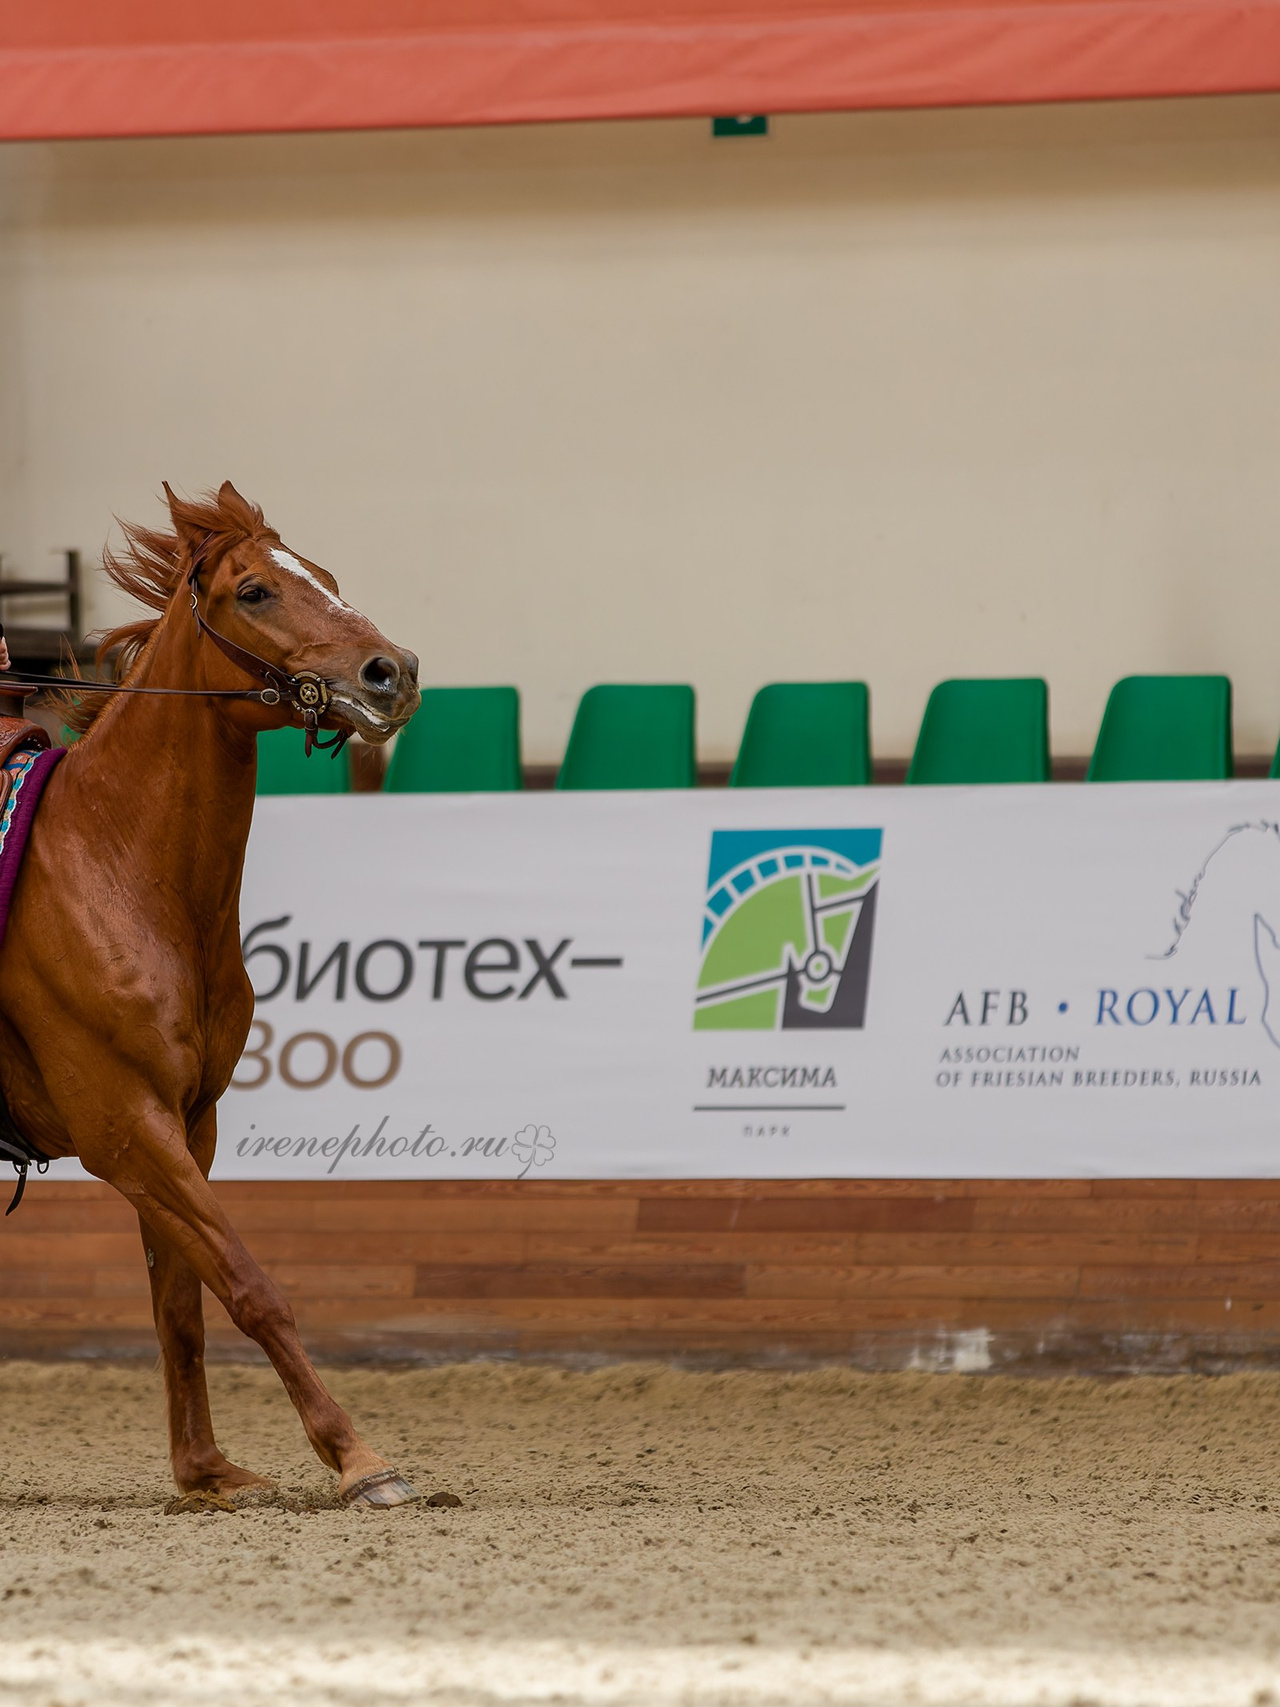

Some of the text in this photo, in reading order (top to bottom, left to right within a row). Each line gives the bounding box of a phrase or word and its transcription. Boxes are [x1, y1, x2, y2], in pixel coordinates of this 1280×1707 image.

[943, 987, 1247, 1026] AFB ROYAL
[939, 1046, 1080, 1064] ASSOCIATION
[706, 1066, 838, 1089] МАКСИМА
[936, 1069, 1261, 1089] OF FRIESIAN BREEDERS, RUSSIA
